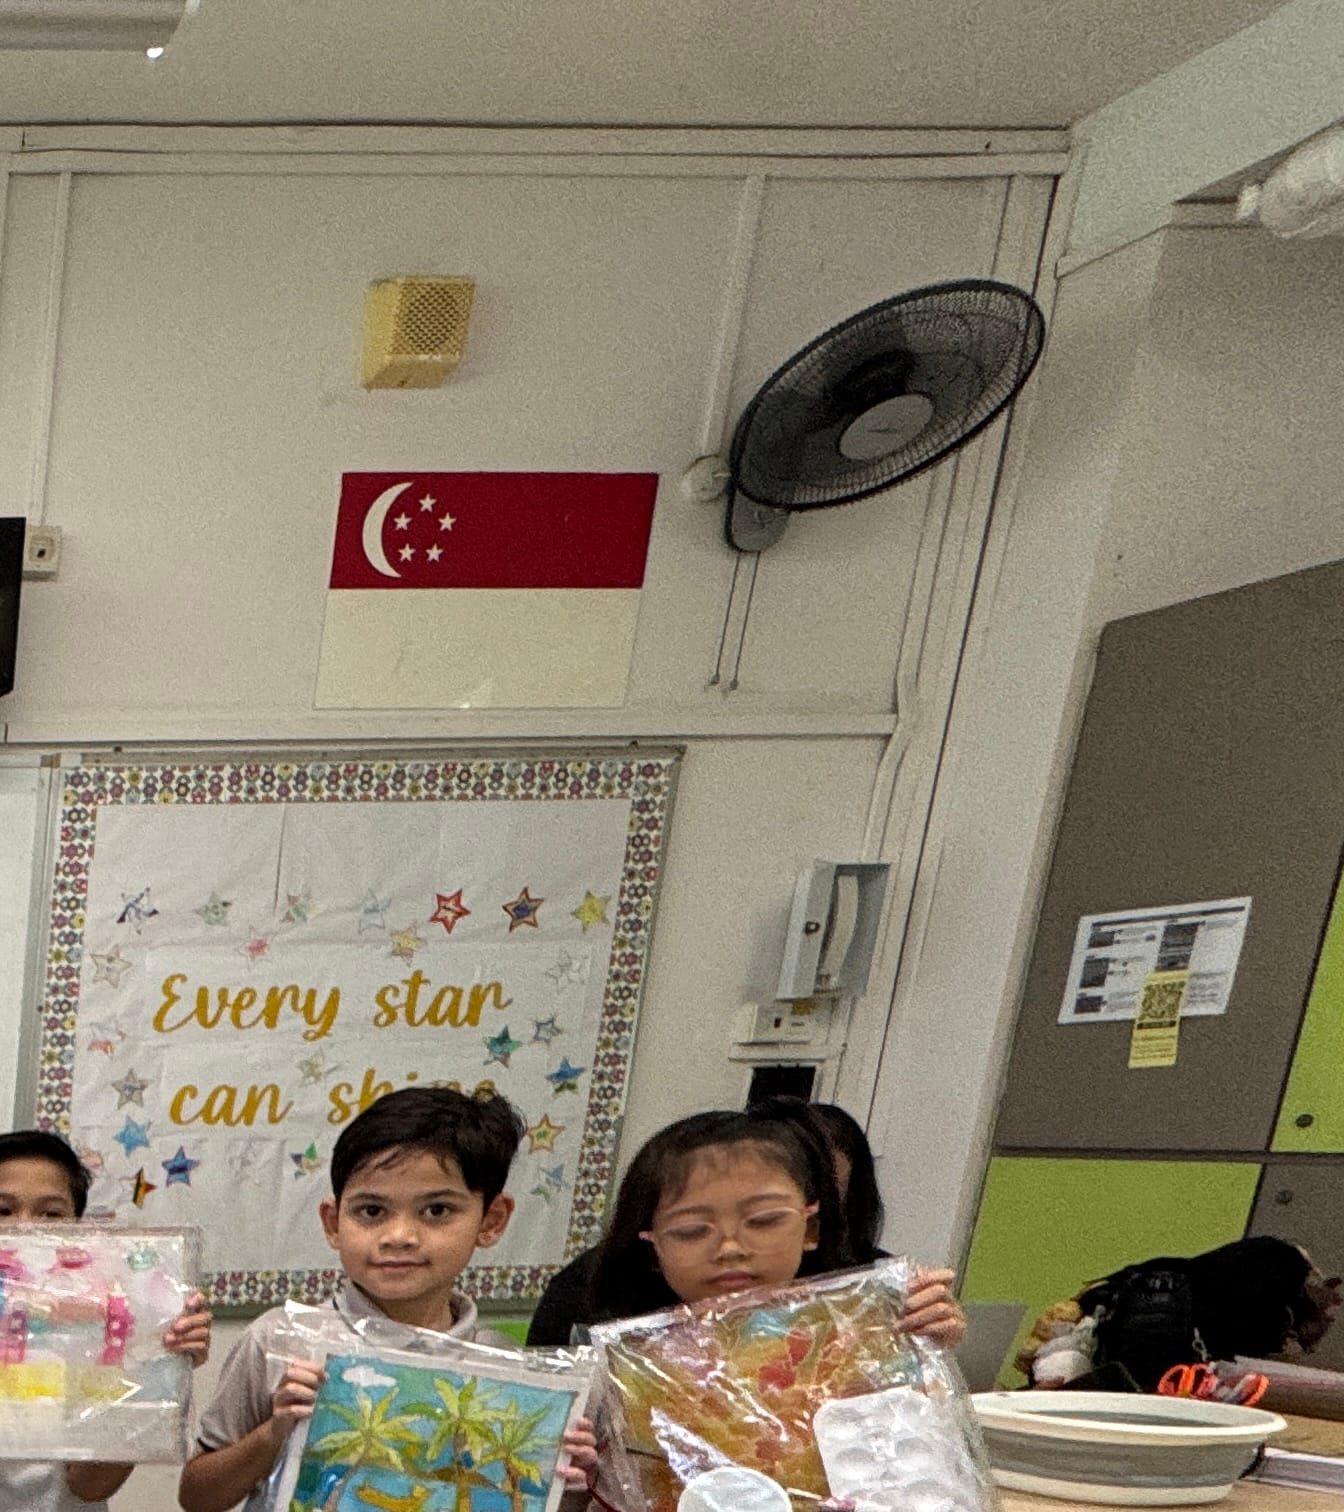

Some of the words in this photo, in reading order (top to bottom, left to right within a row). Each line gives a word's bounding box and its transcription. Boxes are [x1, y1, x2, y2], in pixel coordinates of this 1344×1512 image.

[152, 972, 339, 1041] Every
[373, 969, 513, 1029] star
[170, 1083, 291, 1127] can
